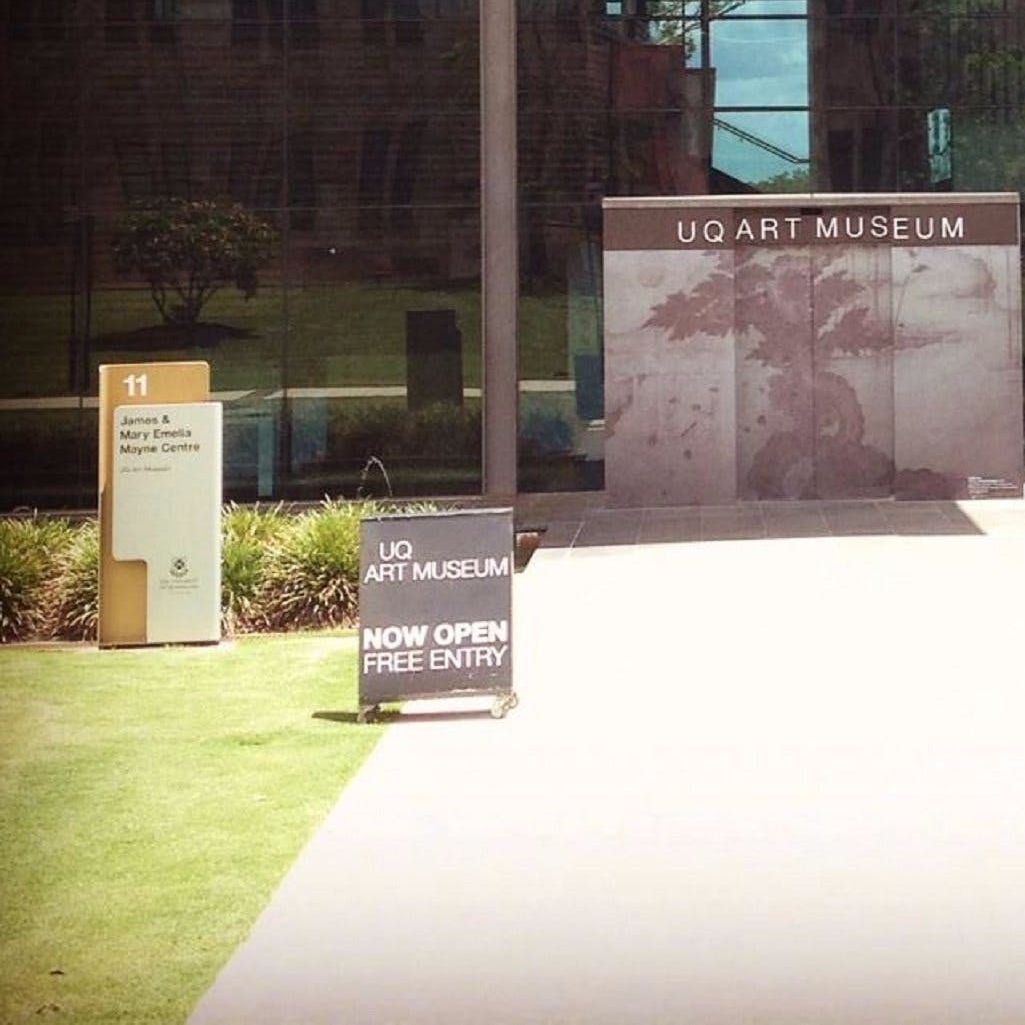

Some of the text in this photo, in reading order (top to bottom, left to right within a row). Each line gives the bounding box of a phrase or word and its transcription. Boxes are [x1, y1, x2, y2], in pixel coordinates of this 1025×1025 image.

[678, 215, 965, 243] UQ ART MUSEUM
[123, 374, 148, 396] 11
[120, 414, 170, 425] James &
[120, 430, 149, 440] Mary
[161, 443, 200, 452] Centre
[379, 541, 412, 560] UQ
[364, 557, 509, 583] ART MUSEUM
[363, 621, 508, 650] NOW OPEN
[363, 646, 508, 674] FREE ENTRY
